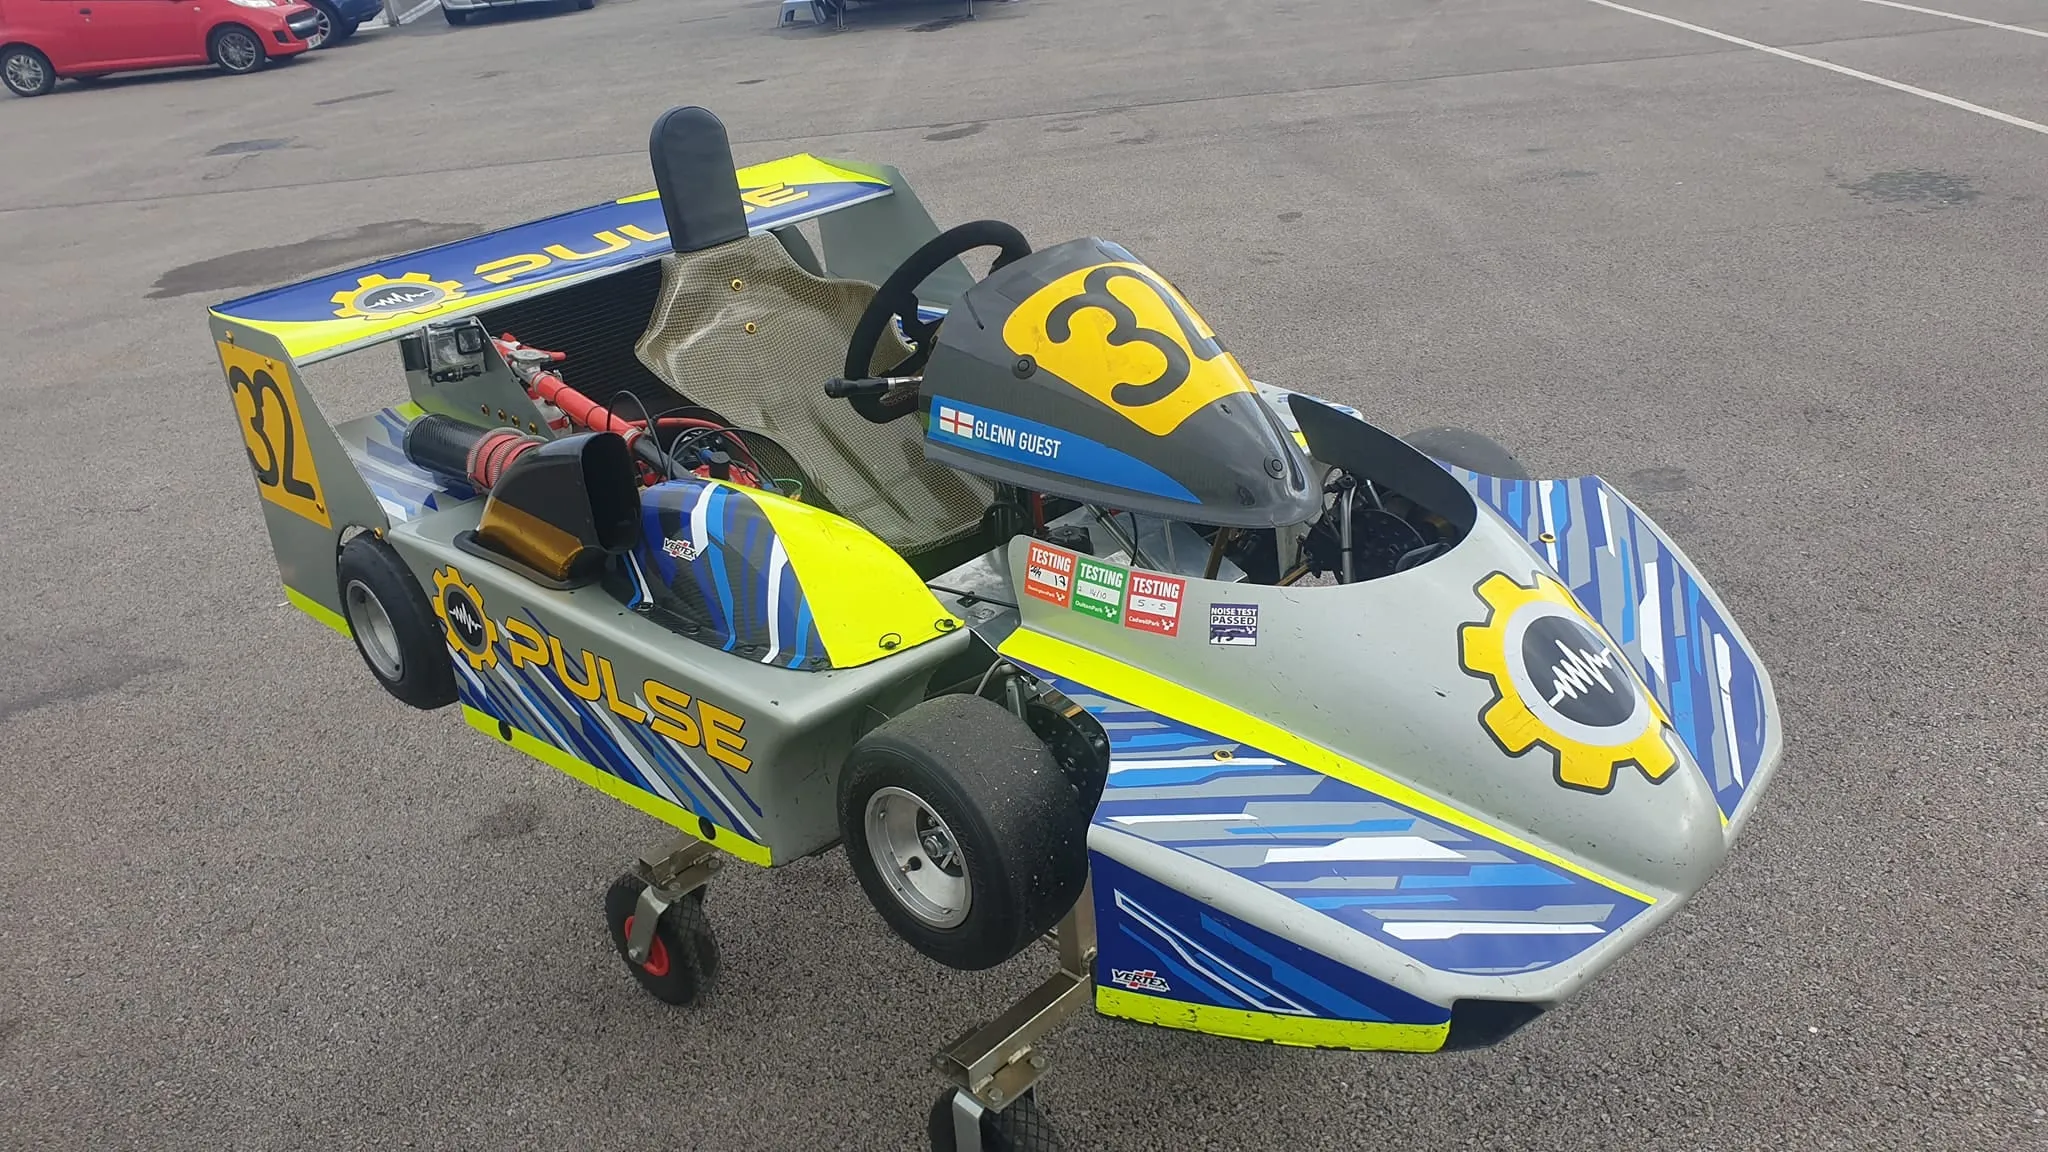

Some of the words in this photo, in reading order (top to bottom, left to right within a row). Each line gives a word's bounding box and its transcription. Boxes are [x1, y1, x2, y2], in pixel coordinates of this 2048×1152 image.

[474, 182, 809, 284] PULE
[229, 365, 316, 501] 32
[975, 420, 1016, 448] GLENN
[1018, 432, 1061, 459] GUEST
[664, 539, 697, 558] VERTEX
[1031, 547, 1072, 573] TESTING
[1080, 563, 1124, 588] TESTING
[1133, 577, 1180, 599] TESTING
[1211, 607, 1236, 615] NOISE
[1237, 608, 1257, 616] TEST
[1212, 616, 1255, 625] PASSED
[504, 617, 753, 773] PULSE
[1114, 970, 1168, 988] VERTEX
